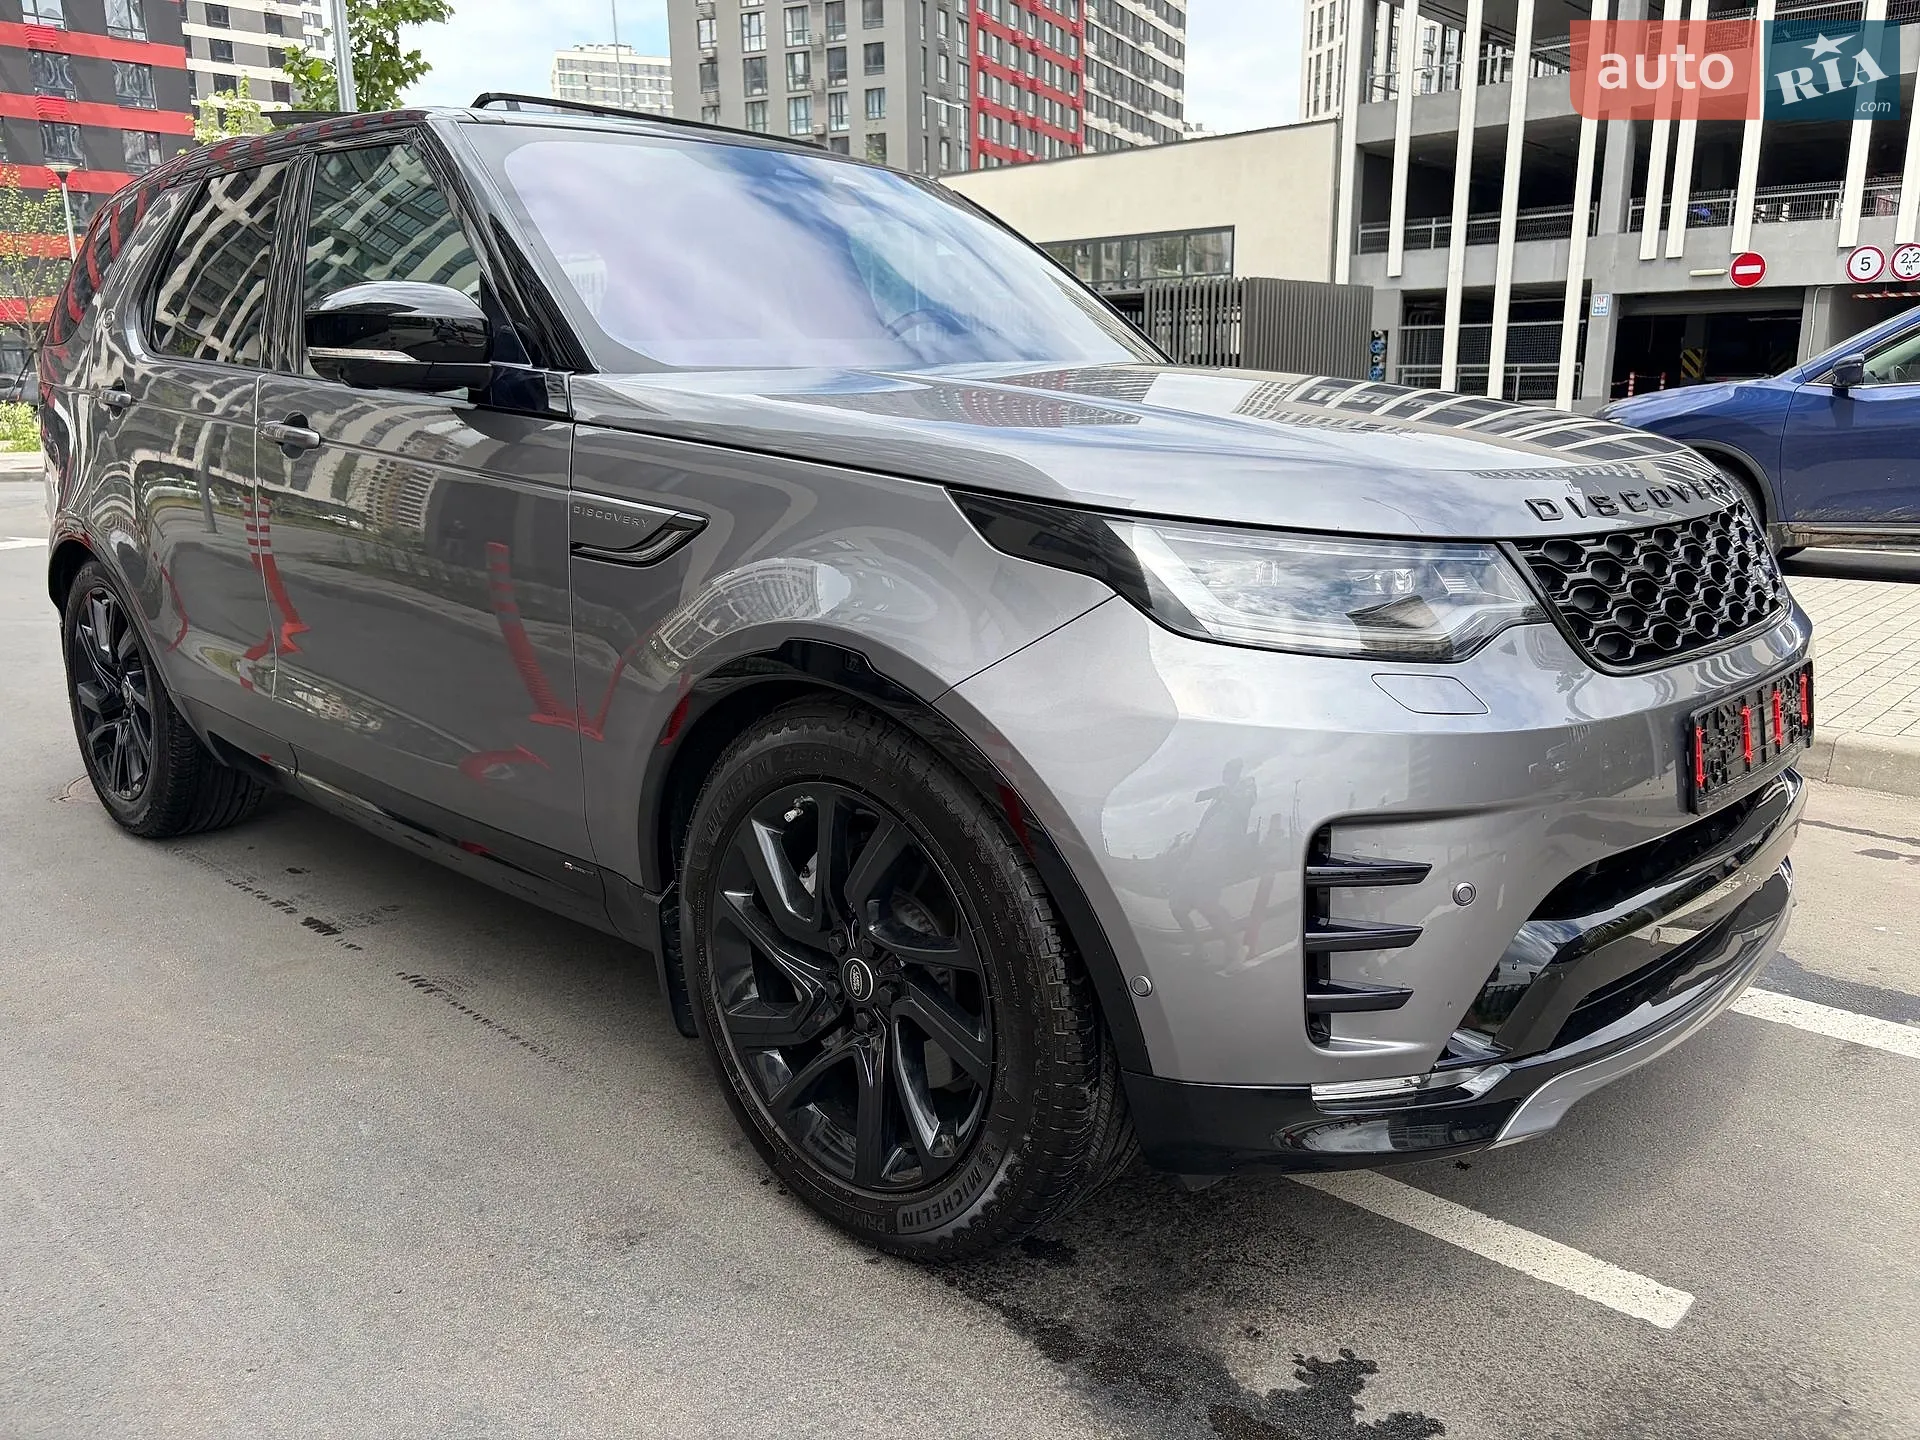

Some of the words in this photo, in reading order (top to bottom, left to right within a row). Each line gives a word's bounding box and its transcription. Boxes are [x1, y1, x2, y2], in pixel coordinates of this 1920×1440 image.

[1860, 256, 1871, 271] 5
[573, 505, 649, 528] DISCOVERY
[902, 1164, 983, 1228] MICHELIN
